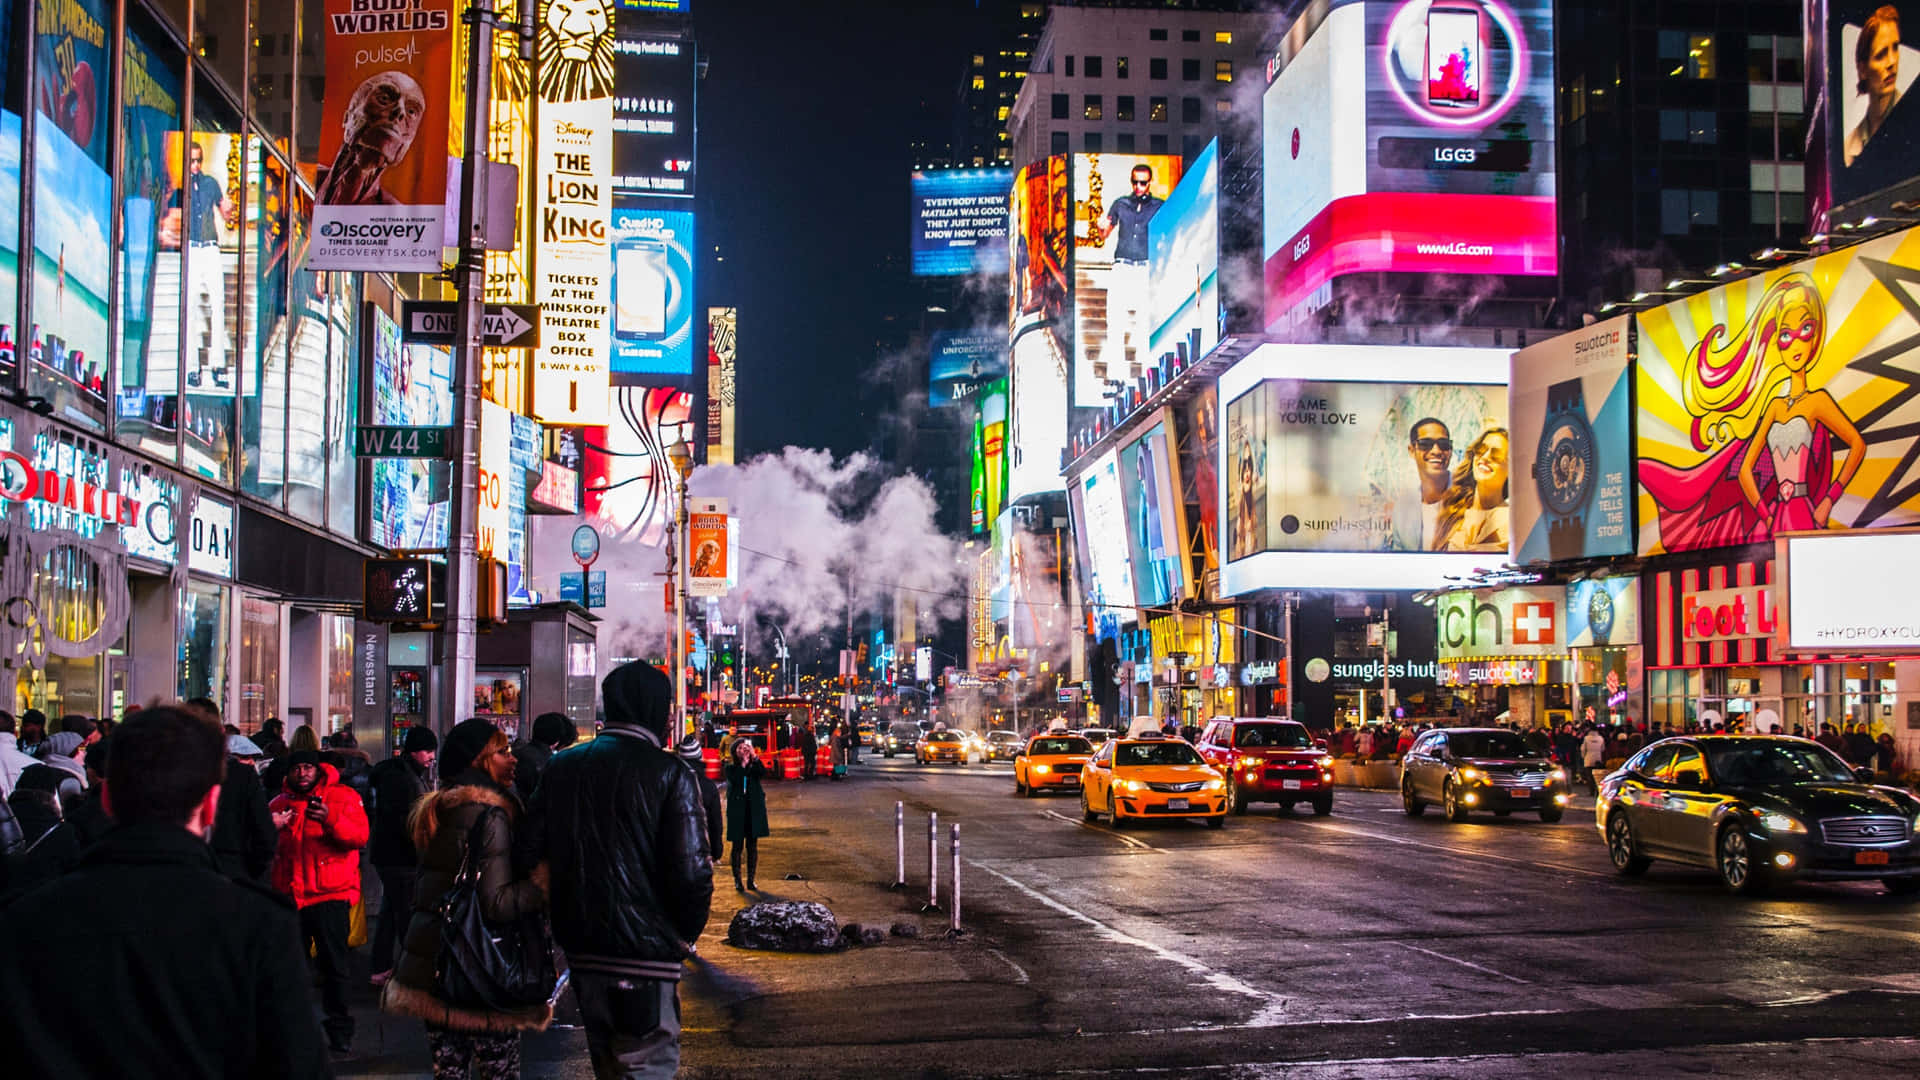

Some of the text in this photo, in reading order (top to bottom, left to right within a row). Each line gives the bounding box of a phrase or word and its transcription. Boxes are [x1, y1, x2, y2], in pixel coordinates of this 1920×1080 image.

[350, 0, 424, 12] BODY
[331, 10, 448, 35] WORLDS
[355, 42, 410, 70] pulse
[553, 120, 594, 139] Disney
[554, 152, 590, 171] THE
[1435, 147, 1475, 163] LG G3
[548, 174, 598, 204] LION
[978, 196, 1005, 205] KNEW
[921, 208, 958, 217] MATILDA
[960, 207, 979, 217] WAS
[543, 207, 605, 242] KING
[926, 219, 949, 228] THEY
[950, 219, 971, 227] JUST
[322, 221, 426, 243] Discovery
[925, 230, 953, 239] KNOW
[954, 229, 976, 238] HOW
[319, 248, 437, 257] DISCOVERYTSX.COM
[1417, 243, 1493, 255] www.LG.com
[548, 274, 599, 286] TICKETS
[551, 289, 595, 300] AT THE
[539, 302, 608, 315] MINSKOFF
[483, 318, 519, 334] WAY
[544, 316, 600, 329] THEATRE
[558, 332, 586, 342] BOX
[1575, 333, 1612, 354] swatch
[550, 346, 594, 357] OFFICE
[1280, 399, 1327, 411] FRAME
[1279, 412, 1357, 425] YOUR LOVE
[362, 430, 385, 454] W
[389, 430, 420, 454] 44
[1606, 473, 1622, 484] THE
[1601, 486, 1623, 498] BACK
[43, 470, 141, 528] OAKLEY
[1598, 498, 1623, 511] TELLS
[1607, 511, 1623, 523] THE
[1597, 524, 1623, 538] STORY
[1684, 594, 1748, 638] Foot
[364, 634, 376, 705] Newsstand
[1332, 659, 1436, 682] sunglass hut
[1468, 663, 1522, 681] swatch
